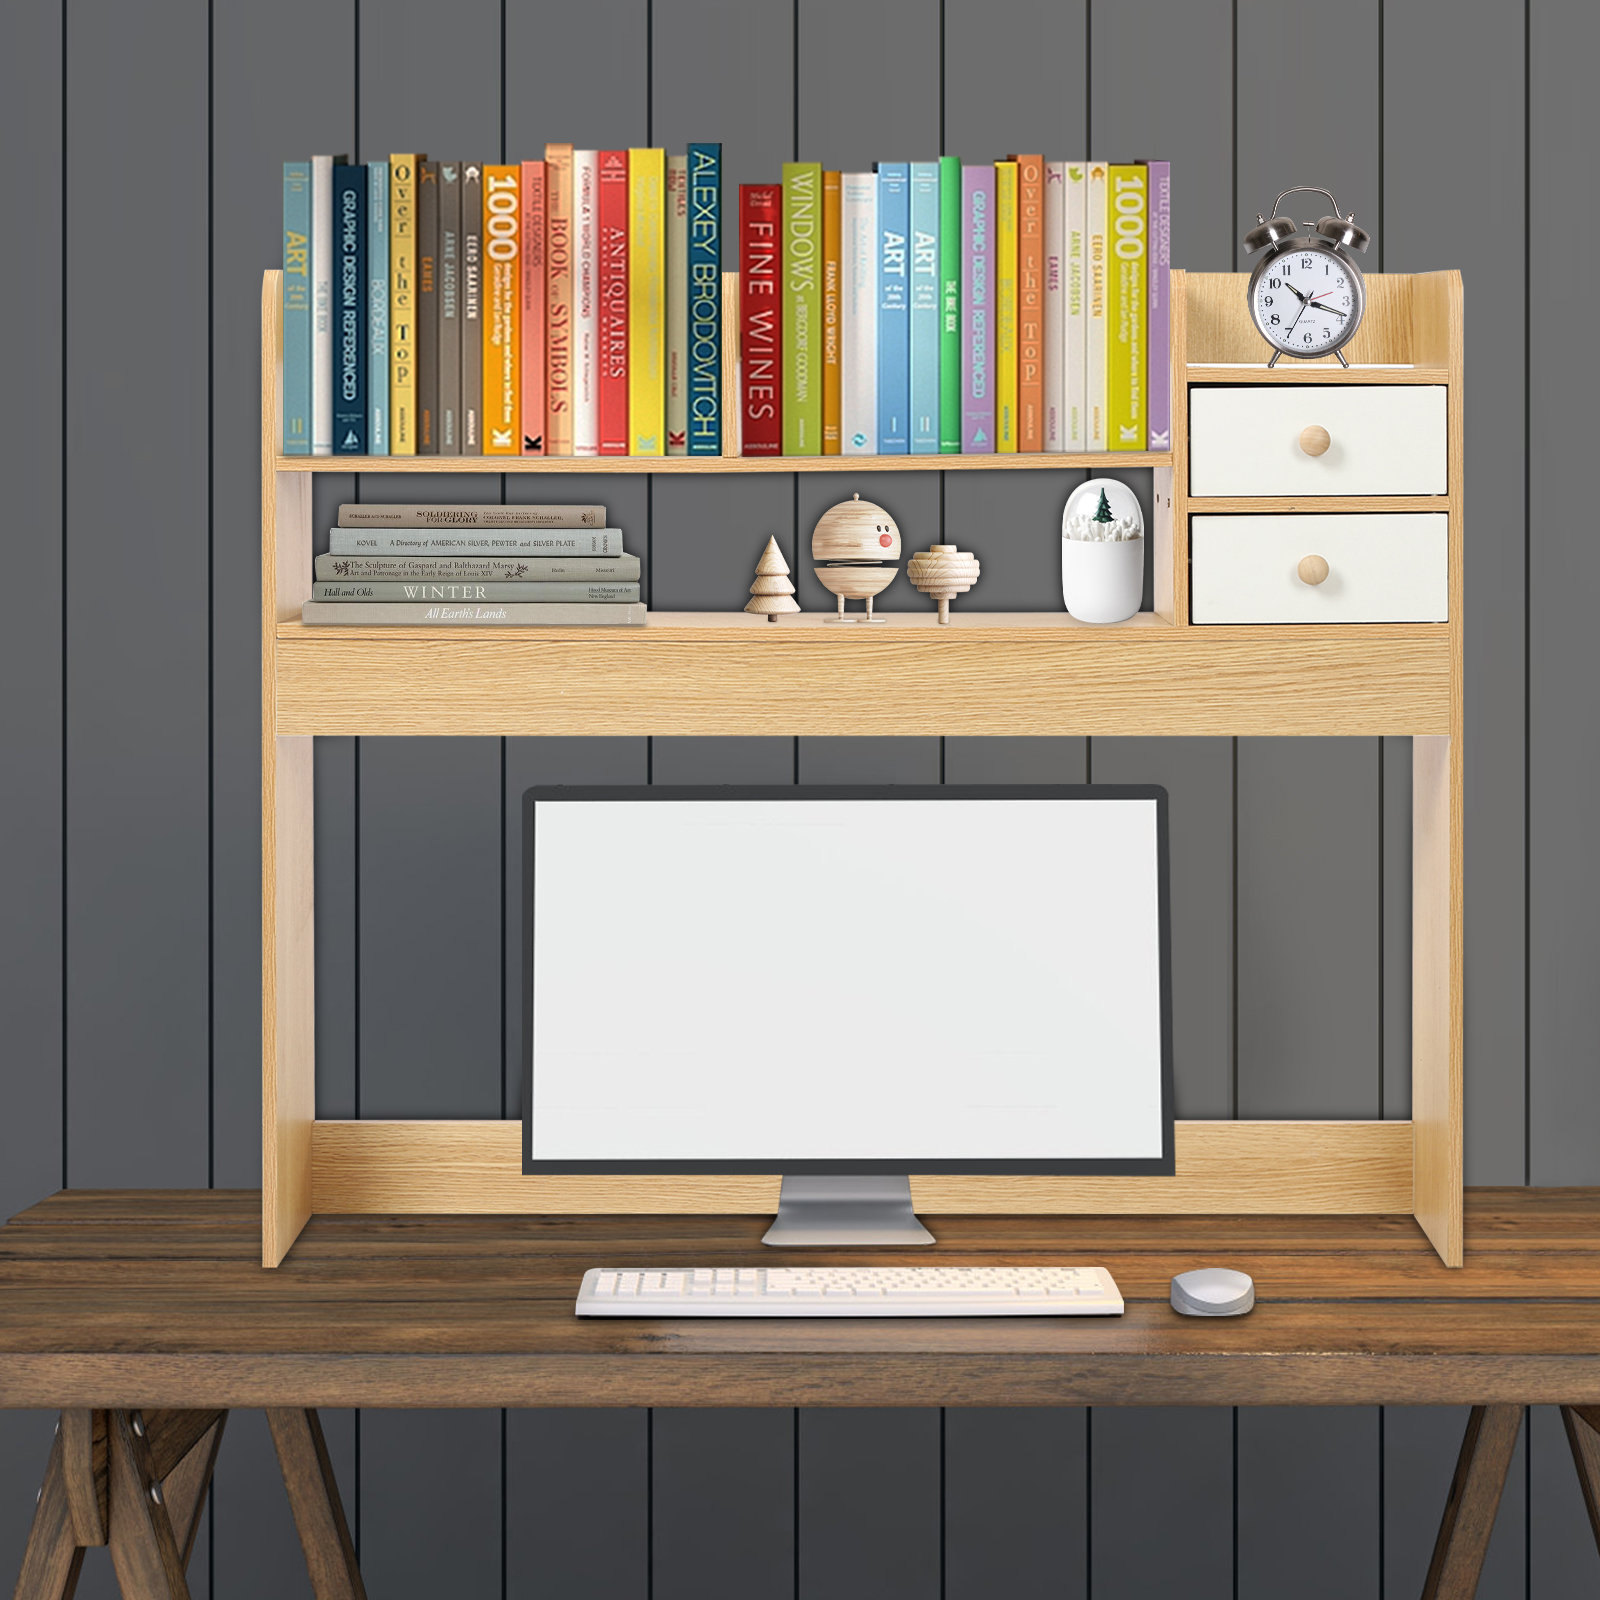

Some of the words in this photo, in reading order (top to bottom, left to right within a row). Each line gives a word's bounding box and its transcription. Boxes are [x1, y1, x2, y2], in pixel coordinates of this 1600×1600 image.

[532, 177, 542, 212] TEXTILE
[582, 166, 590, 214] FORMULA
[693, 152, 716, 255] ALEXEY
[1159, 176, 1169, 212] TEXTILE
[342, 190, 356, 252] GRAPHIC
[488, 175, 518, 260] 1000
[790, 172, 814, 291] WINDOWS
[972, 191, 985, 252] GRAPHIC
[1115, 176, 1144, 259] 1000
[287, 231, 306, 276] ART
[444, 232, 454, 260] ARNE
[466, 235, 476, 261] EERO
[532, 215, 542, 267] DESIGNERS
[550, 218, 568, 279] BOOK
[749, 222, 773, 294] FINE
[884, 231, 904, 276] ART
[915, 231, 935, 276] ART
[1070, 231, 1080, 258] ARNE
[1092, 234, 1102, 261] EERO
[1159, 215, 1169, 266] DESIGNERS
[342, 256, 356, 306] DESIGN
[422, 257, 433, 292] EAMES
[826, 261, 836, 292] FRANK
[972, 256, 985, 304] DESIGN
[1048, 256, 1058, 291] EAMES
[1269, 278, 1281, 289] 10
[1283, 265, 1291, 275] 11
[1302, 258, 1312, 269] 12
[1325, 265, 1329, 275] 1
[1337, 278, 1344, 288] 2
[444, 263, 454, 318] JACOBSEN
[466, 265, 476, 319] SAARINEN
[582, 261, 590, 318] CHAMPIONS
[608, 228, 624, 378] ANTIQUAIRES
[826, 294, 836, 324] LLOYD
[1070, 262, 1080, 316] JACOBSEN
[1092, 265, 1102, 318] SAARINEN
[1265, 296, 1273, 307] 9
[1342, 296, 1350, 306] 3
[1271, 314, 1280, 325] 8
[1304, 333, 1312, 343] 6
[1323, 328, 1331, 338] 5
[1336, 315, 1345, 325] 4
[342, 310, 356, 400] REFERENCED
[550, 304, 568, 412] SYMBOLS
[693, 264, 716, 436] BRODOVITCH
[749, 311, 773, 418] WINES
[826, 327, 836, 364] WRIGHT
[972, 310, 985, 398] REFERENCED
[396, 540, 421, 549] Directory
[423, 540, 429, 548] of
[365, 561, 397, 571] Sculpture
[408, 562, 437, 571] Gaspard
[492, 562, 514, 571] Marsy
[324, 588, 340, 597] Hall
[341, 588, 355, 597] and
[356, 588, 373, 597] Olds
[403, 585, 486, 599] WINTER
[425, 608, 439, 619] All
[441, 608, 474, 619] Earth's
[475, 608, 507, 619] Lands
